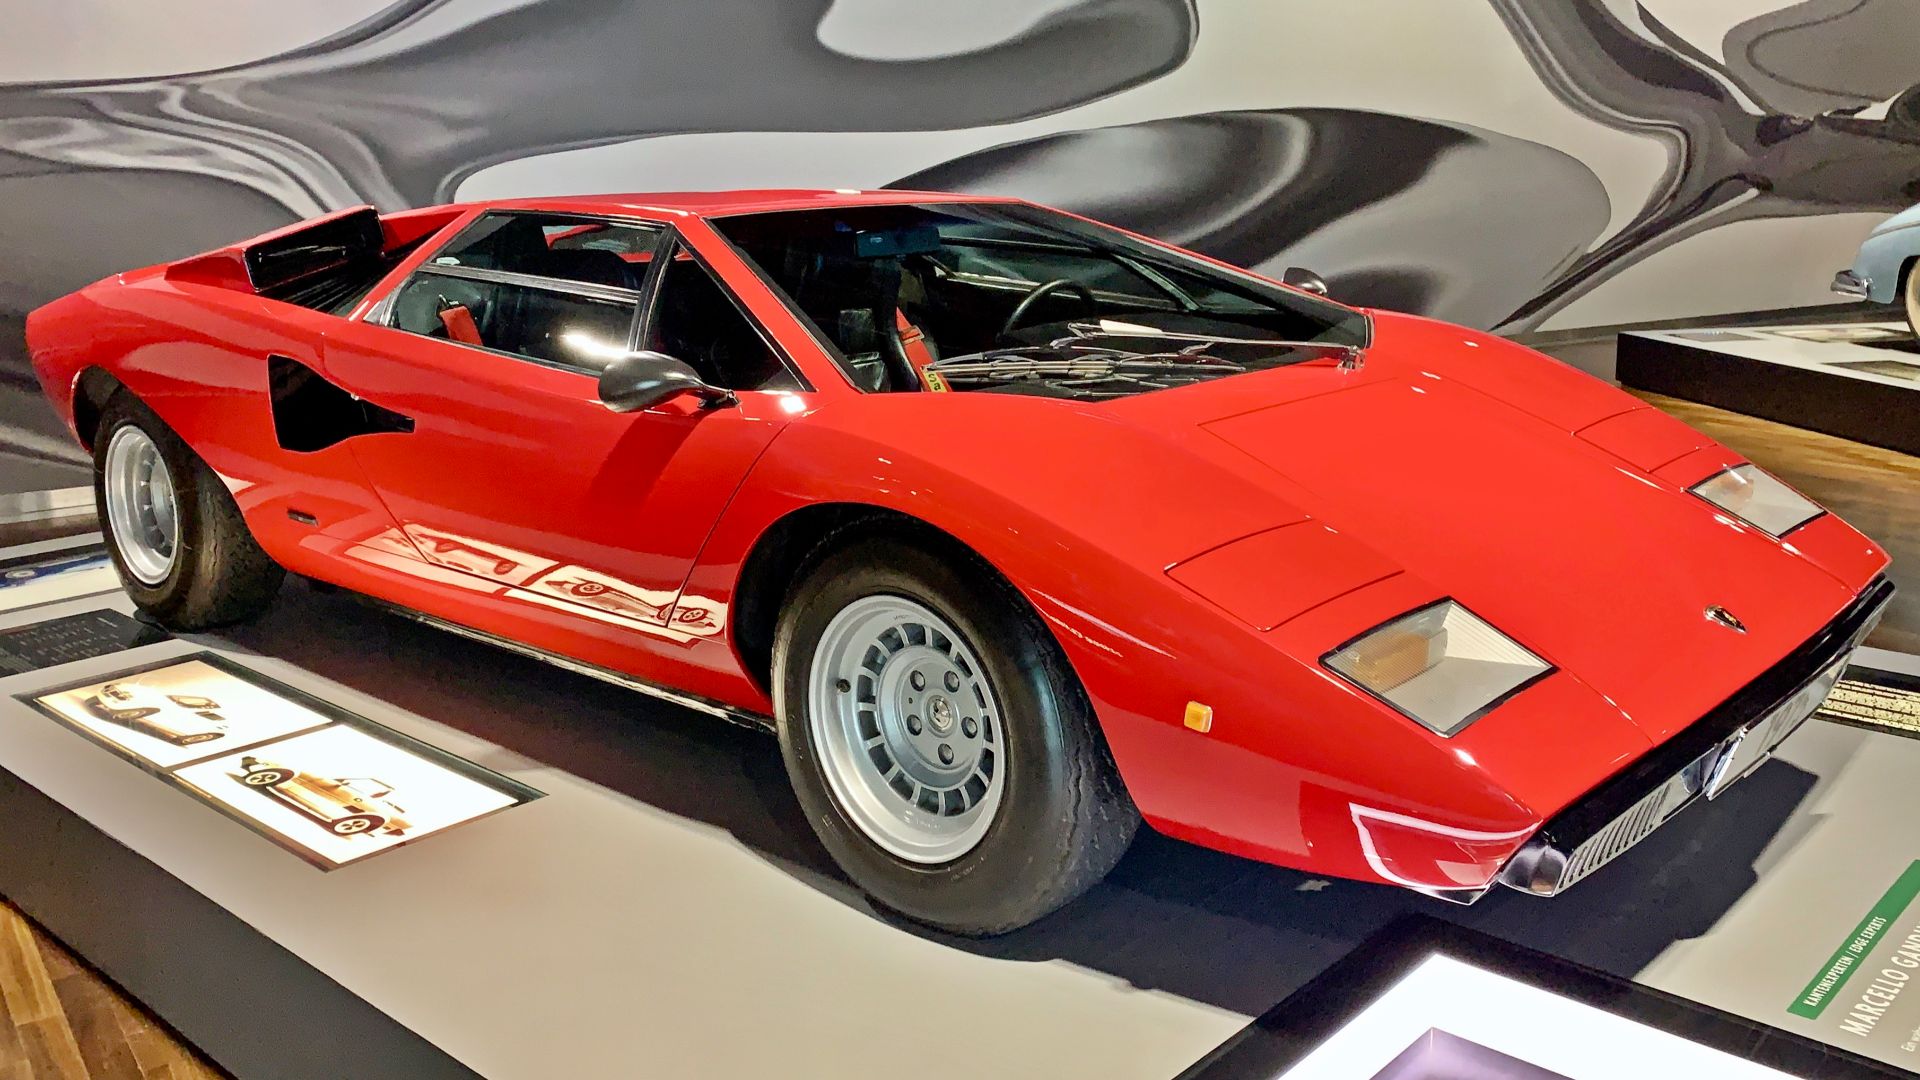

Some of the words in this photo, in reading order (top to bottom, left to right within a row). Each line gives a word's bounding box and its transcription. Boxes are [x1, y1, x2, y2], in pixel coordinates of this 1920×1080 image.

[1803, 955, 1854, 1007] KANTENEXPERTEN
[1849, 937, 1869, 953] EDGE
[1861, 916, 1887, 939] EXPERTS
[1840, 969, 1910, 1037] MARCELLO
